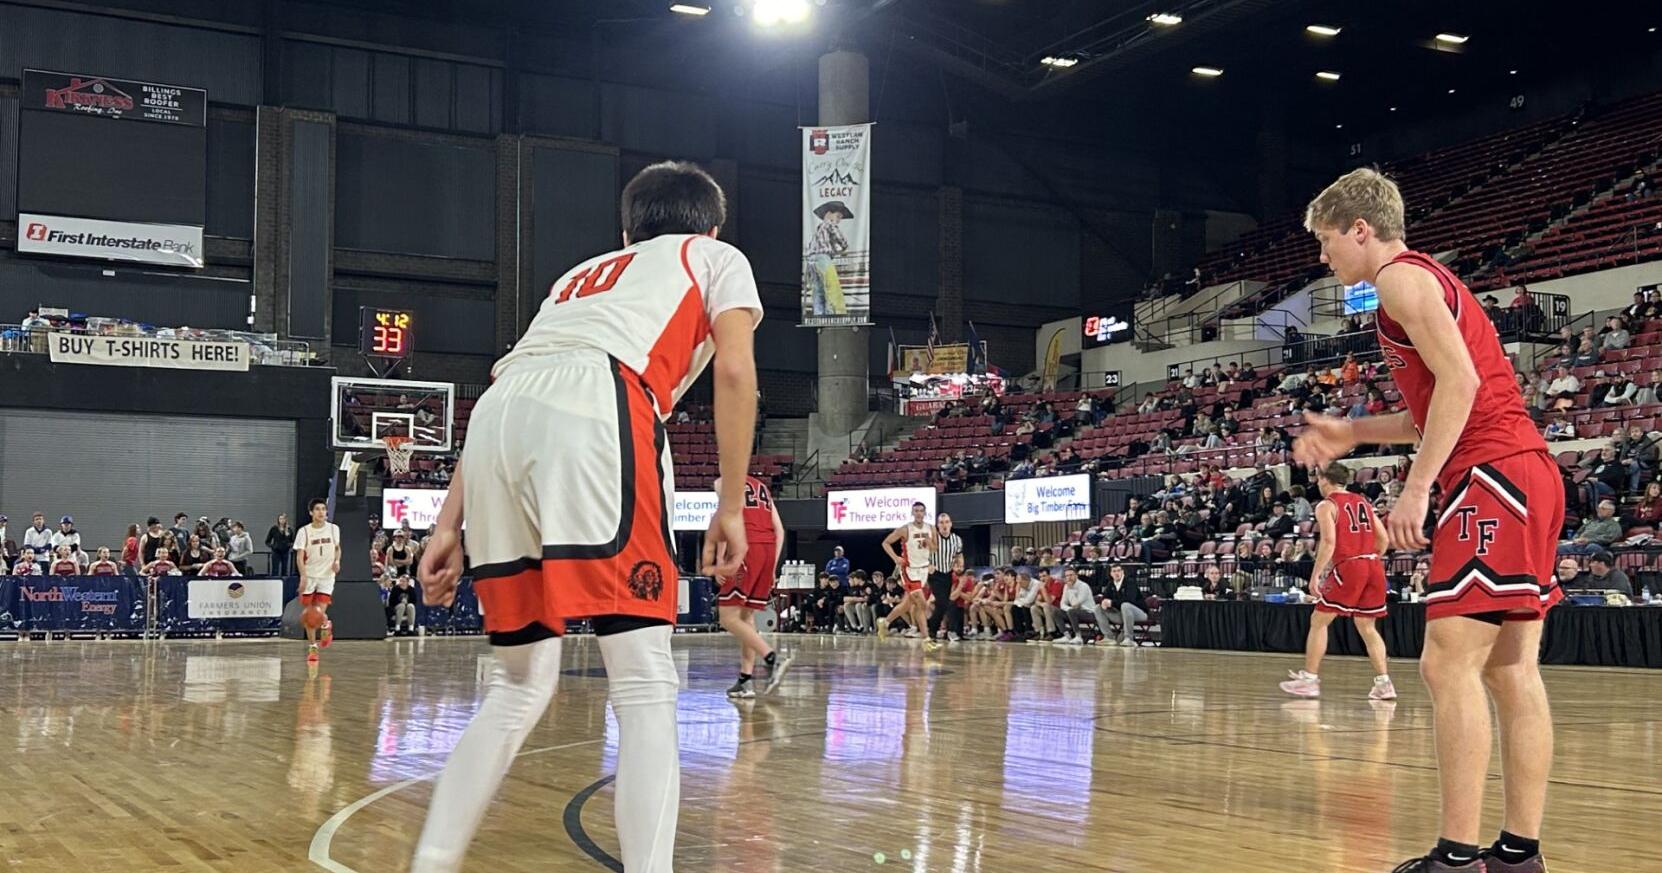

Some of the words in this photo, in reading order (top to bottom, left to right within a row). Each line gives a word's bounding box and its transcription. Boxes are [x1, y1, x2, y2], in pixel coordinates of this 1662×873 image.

[142, 85, 182, 97] BILLINGS
[151, 92, 172, 101] BEST
[143, 97, 180, 109] ROOFER
[1509, 94, 1525, 109] 49
[1349, 143, 1361, 155] 51
[819, 187, 854, 198] LEGACY
[47, 229, 85, 245] First
[86, 233, 161, 250] Interstate
[162, 239, 194, 254] Bank
[555, 252, 638, 304] 10
[1555, 300, 1567, 313] 19
[376, 313, 409, 329] 4:12
[373, 326, 402, 353] 33
[59, 337, 94, 354] BUY
[106, 340, 180, 359] T-SHIRTS
[192, 344, 239, 362] HERE!
[1105, 374, 1119, 384] 23
[1170, 368, 1179, 377] 21
[744, 481, 772, 513] 24
[1036, 486, 1075, 498] Welcome
[674, 499, 720, 510] elcome
[1027, 502, 1040, 515] Big
[1040, 501, 1065, 513] Timber
[674, 512, 706, 522] imber
[849, 511, 877, 522] Three
[879, 511, 907, 522] Forks
[1344, 501, 1372, 533] 14
[1455, 504, 1499, 556] TF
[19, 585, 119, 602] NorthWestern
[81, 601, 118, 615] Energy
[199, 601, 240, 609] FARMERS
[243, 601, 272, 609] UNION
